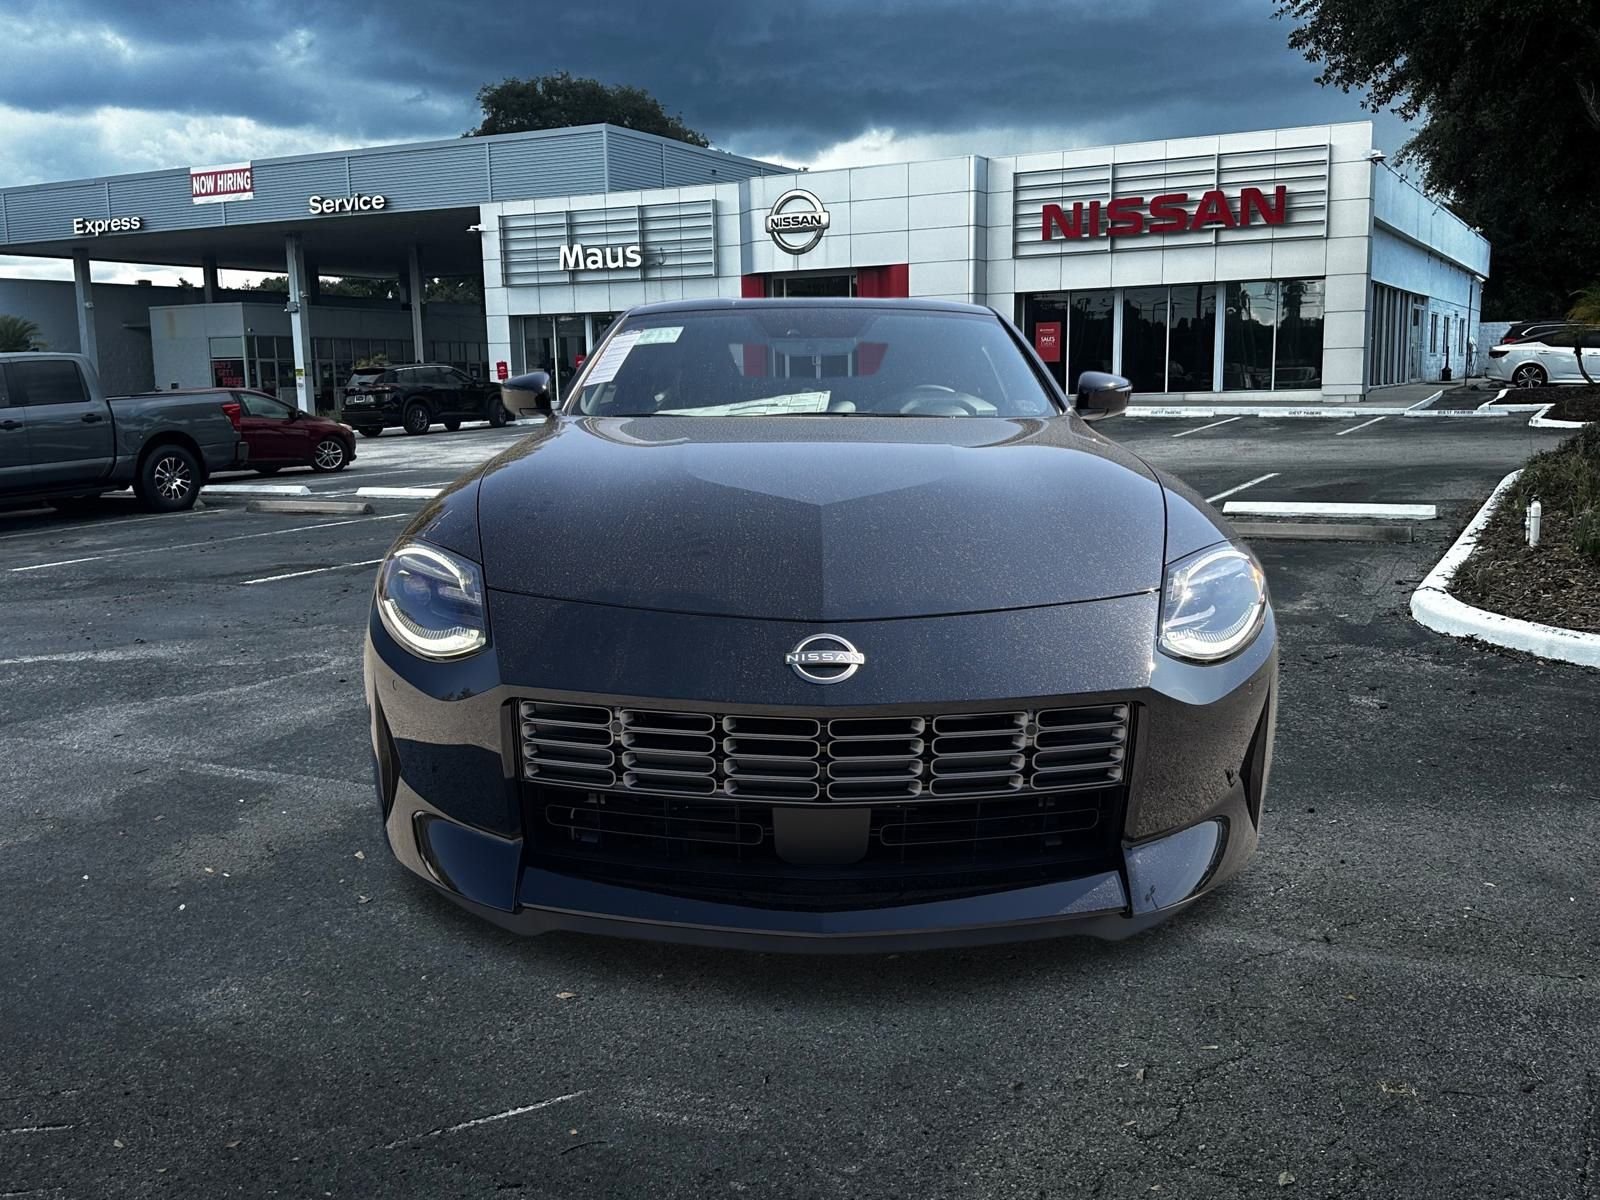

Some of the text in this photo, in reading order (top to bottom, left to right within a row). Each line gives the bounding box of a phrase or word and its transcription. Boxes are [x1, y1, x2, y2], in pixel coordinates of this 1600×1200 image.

[192, 171, 250, 195] NOW HIRING
[309, 193, 385, 214] Service
[1042, 185, 1287, 241] NISSAN
[73, 216, 141, 236] Express
[770, 215, 821, 228] NISSAN
[559, 243, 642, 271] Maus
[786, 653, 863, 662] NISSAN
